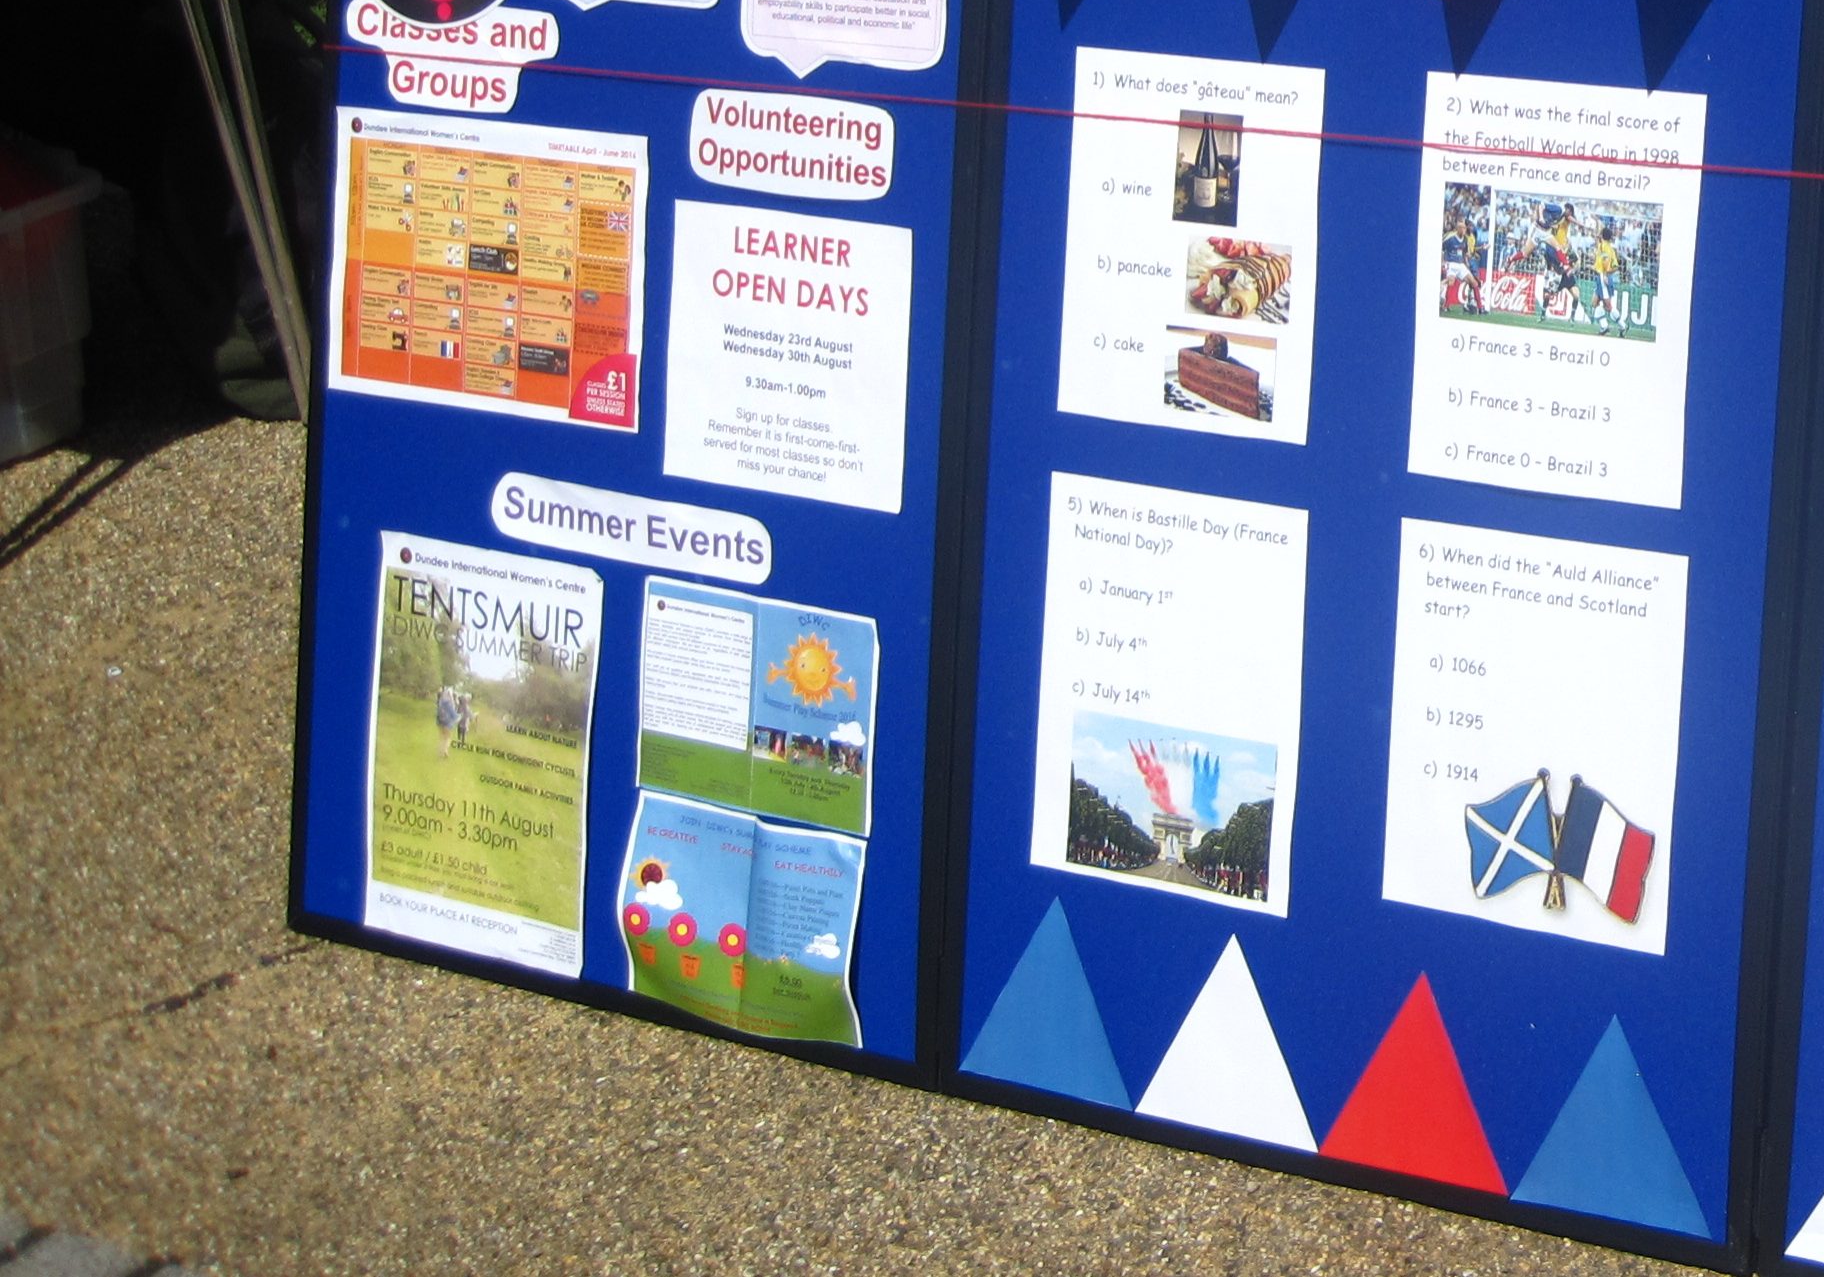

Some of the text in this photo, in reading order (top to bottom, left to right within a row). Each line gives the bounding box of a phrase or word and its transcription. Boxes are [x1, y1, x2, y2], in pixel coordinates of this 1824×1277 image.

[490, 19, 548, 50] and
[393, 61, 507, 108] Groups
[1092, 70, 1299, 105] 1) What does "gâteau" mean?
[706, 96, 882, 151] Volunteering
[1446, 96, 1681, 133] 2) What was the final score of
[698, 134, 887, 188] Opportunities
[734, 226, 851, 268] LEARNER
[712, 268, 869, 317] OPEN DAYS
[722, 339, 852, 371] Wednesday 30th August
[723, 323, 853, 354] Wednesday 23rd August
[1093, 332, 1145, 353] c) cake
[608, 371, 626, 391] £1
[745, 375, 826, 400] 9.30am-1.00pm
[707, 418, 861, 455] Remember it is first-come-first-
[735, 406, 831, 433] Sign up for classes.
[504, 486, 764, 565] Summer Events
[1067, 496, 1289, 546] 5) When is Bastille Day (France
[1074, 523, 1174, 555] National Day)?
[414, 552, 586, 595] Dundee International Women's Centre
[1419, 543, 1660, 591] 6) When did the "Auld Alliance"
[393, 575, 584, 649] TENTSMUIR
[1424, 601, 1471, 619] start?
[1426, 571, 1648, 618] between France and Scotland
[393, 615, 588, 673] DIWC SUMMER TRIP
[383, 783, 555, 839] Thursday 11th August
[383, 804, 443, 833] 9.00am
[458, 821, 519, 852] 3.30pm
[379, 892, 518, 935] BOOK YOUR PLACE AT RECEPTION
